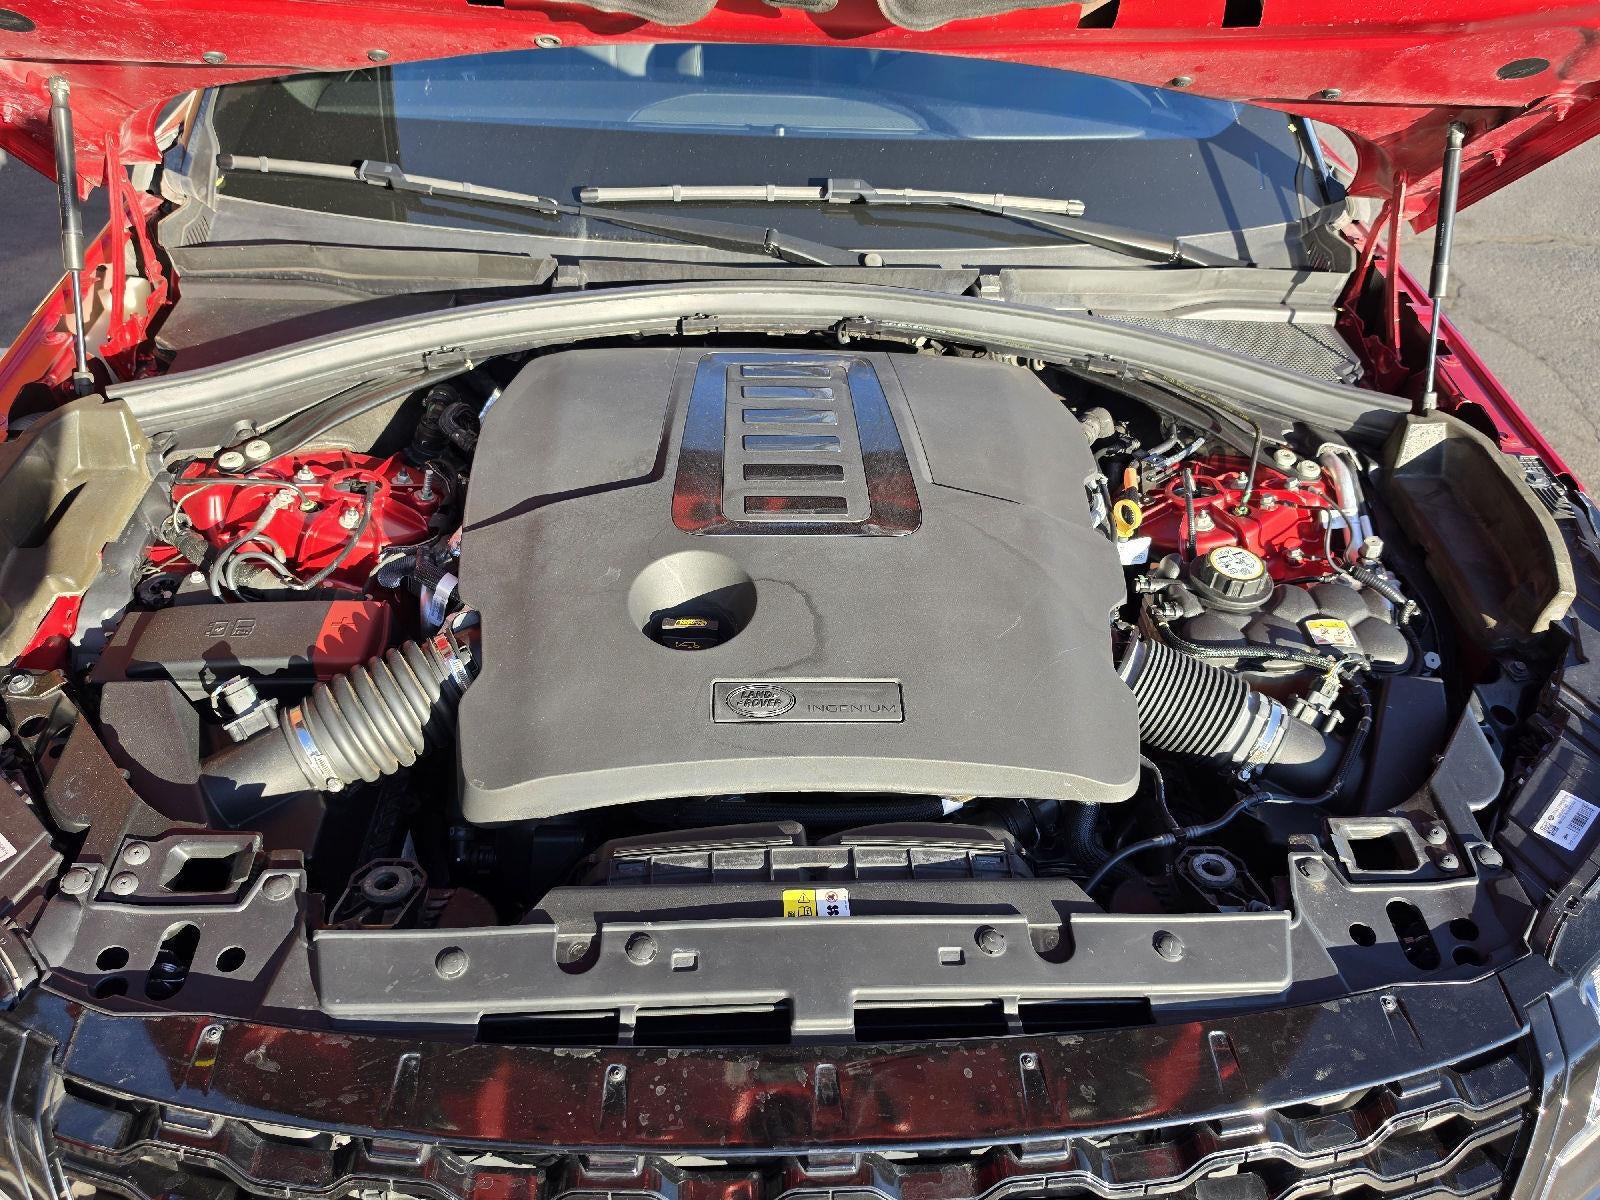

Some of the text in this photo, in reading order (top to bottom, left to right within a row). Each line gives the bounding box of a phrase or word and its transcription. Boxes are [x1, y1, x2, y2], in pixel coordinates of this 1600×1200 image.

[740, 690, 773, 699] LAND
[743, 698, 783, 708] ROVER
[807, 703, 897, 713] INGENIUM
